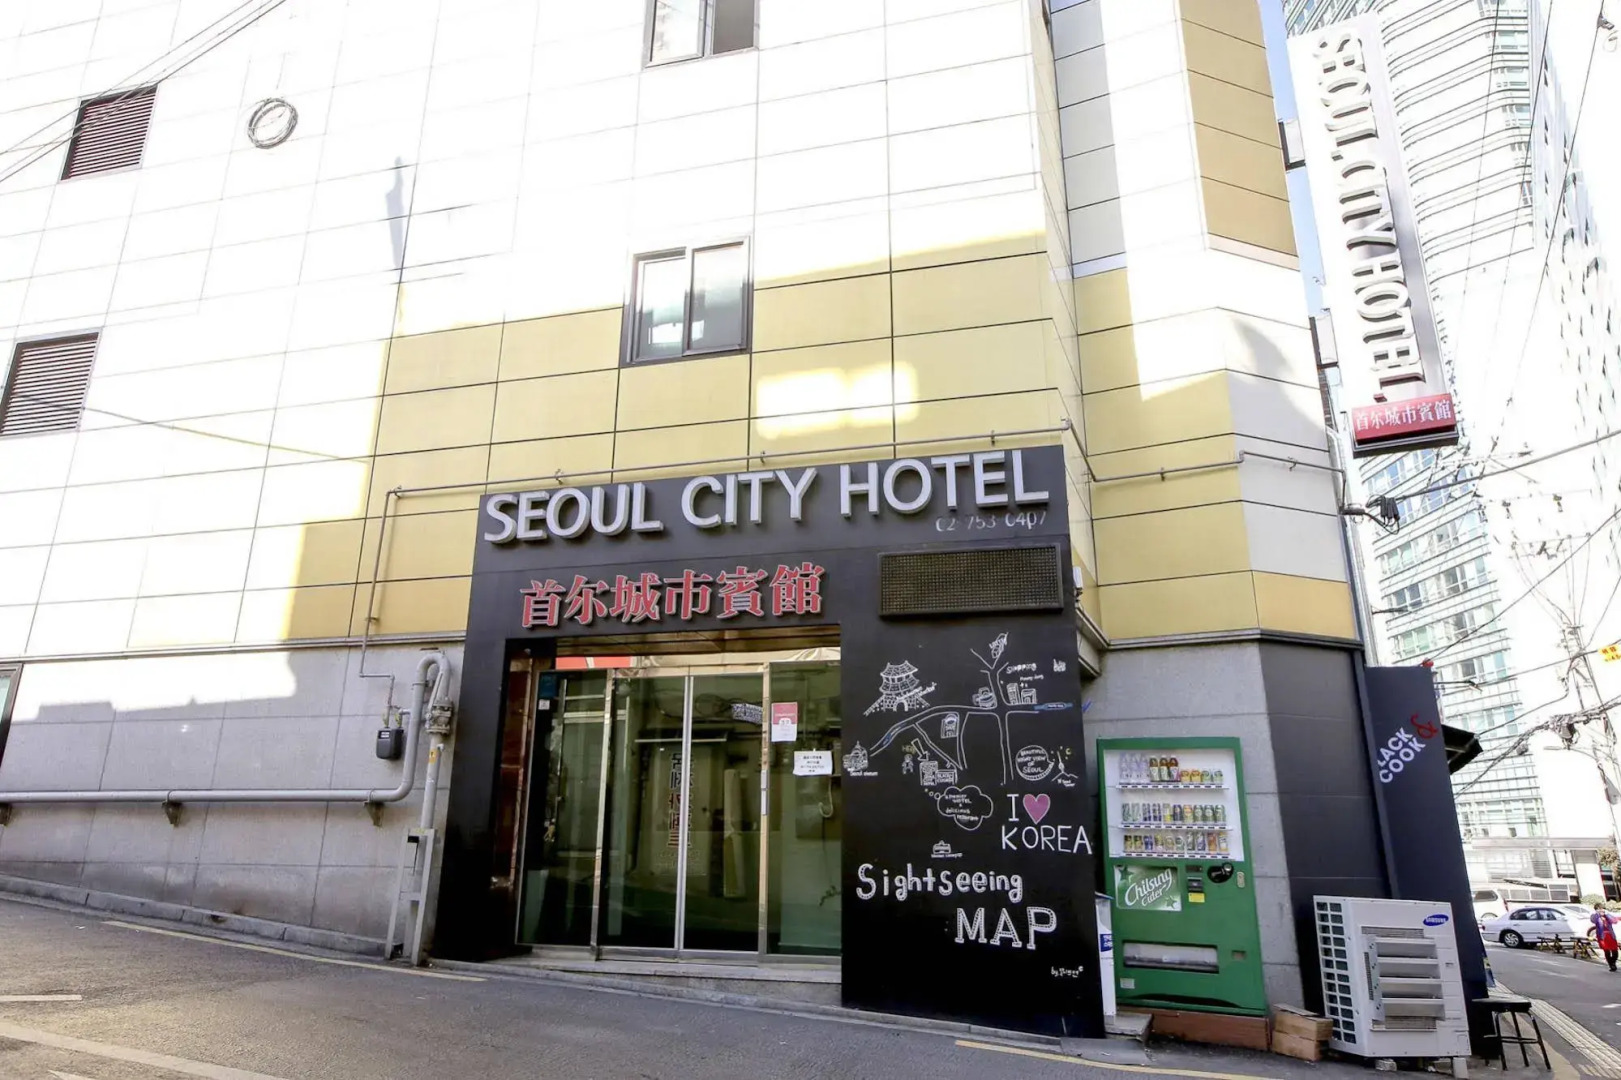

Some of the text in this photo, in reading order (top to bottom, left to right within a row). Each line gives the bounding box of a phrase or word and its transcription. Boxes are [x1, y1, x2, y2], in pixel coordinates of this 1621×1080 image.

[1314, 33, 1426, 404] SEOUL CITY HOTEL
[484, 449, 1050, 545] SEOUL CITY HOTEL
[1379, 737, 1426, 783] COOK
[1006, 793, 1019, 822] I
[1001, 825, 1093, 854] KOREA
[856, 863, 1023, 903] Sightseeing
[1125, 868, 1172, 906] Chilsung
[954, 906, 1058, 950] MAP
